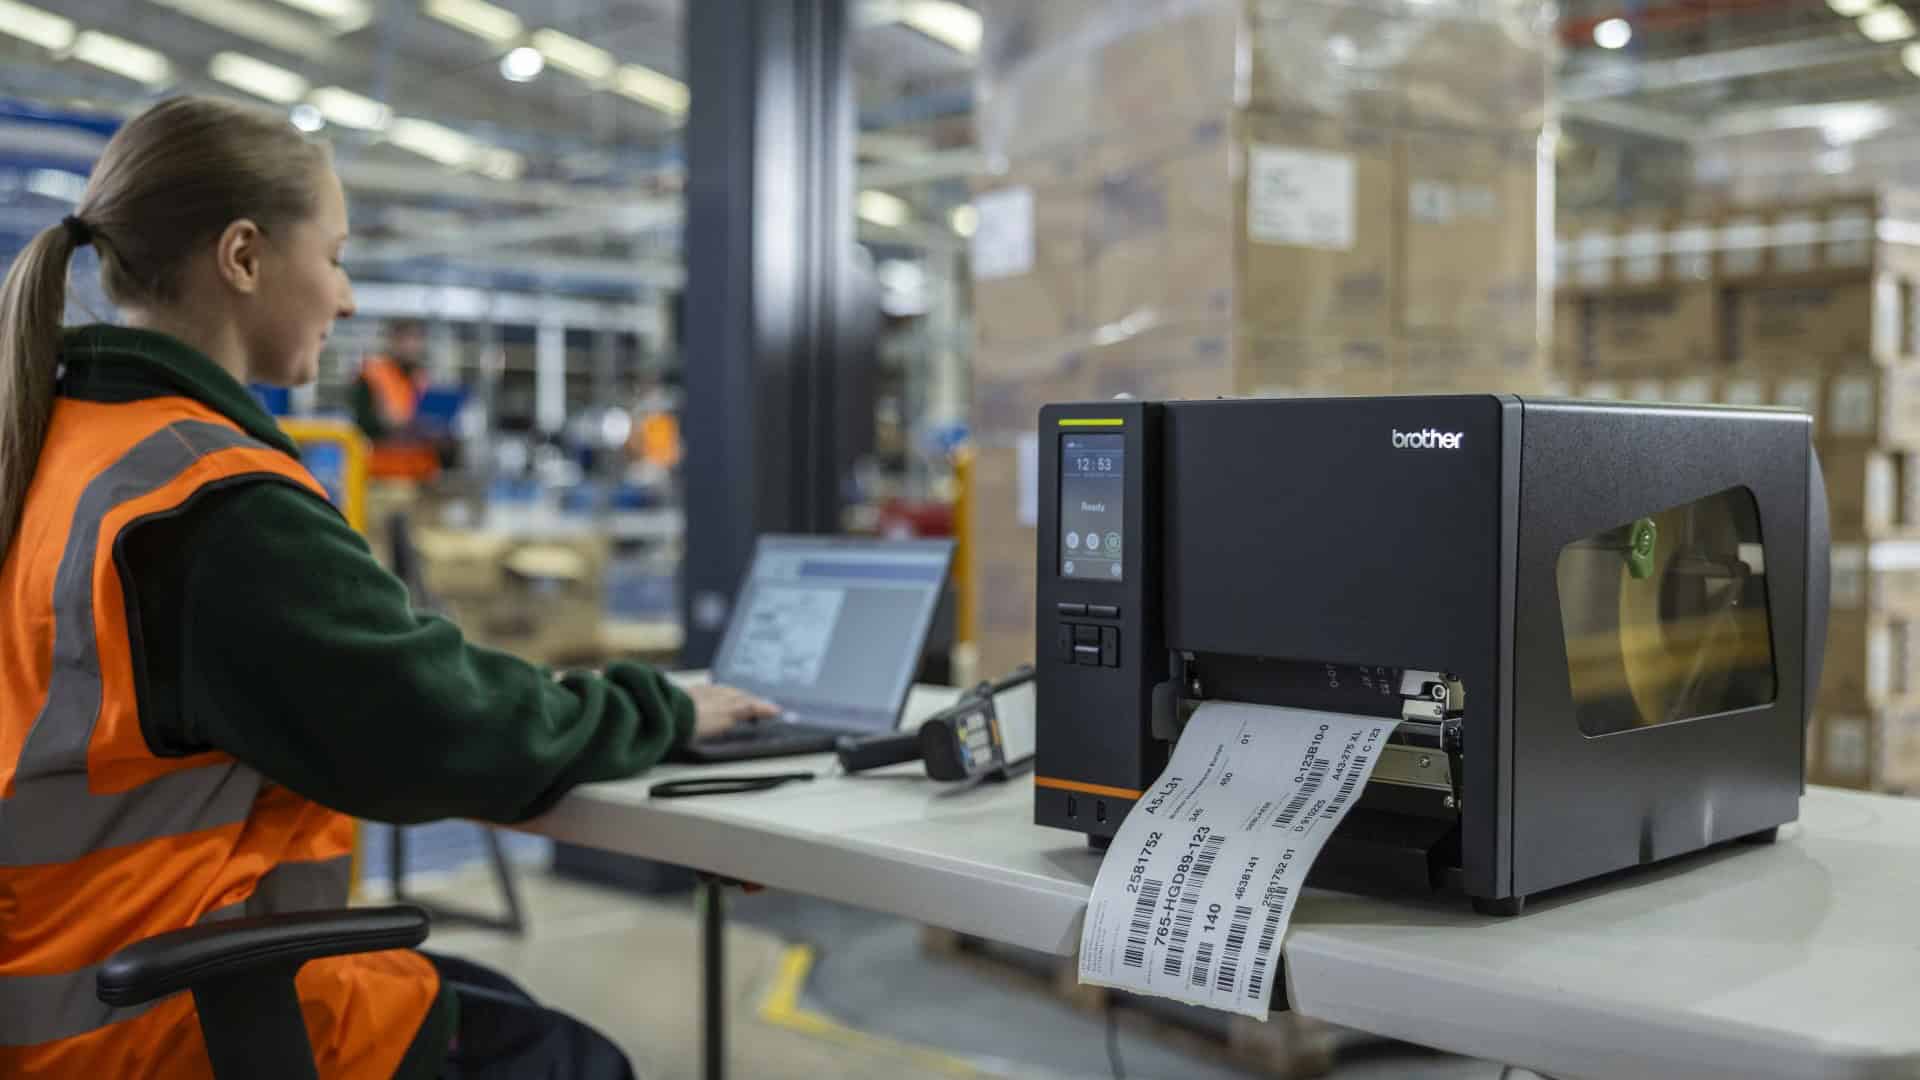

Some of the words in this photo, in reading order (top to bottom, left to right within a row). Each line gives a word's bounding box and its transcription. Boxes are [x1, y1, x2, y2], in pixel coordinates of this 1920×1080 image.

[1392, 428, 1464, 448] brother
[1081, 501, 1105, 512] Ready
[1241, 734, 1251, 745] 01
[1350, 730, 1363, 743] XL
[1362, 744, 1373, 753] C
[1367, 728, 1382, 743] 123
[1294, 724, 1330, 783] 0-123B10-0
[1145, 777, 1184, 815] A5-L31
[1126, 831, 1163, 894] 2581752
[1234, 855, 1260, 900] 4638141
[1262, 862, 1289, 907] 2581752
[1282, 848, 1296, 860] 01
[1153, 826, 1211, 947] 765-HGD89-123
[1203, 903, 1222, 934] 140
